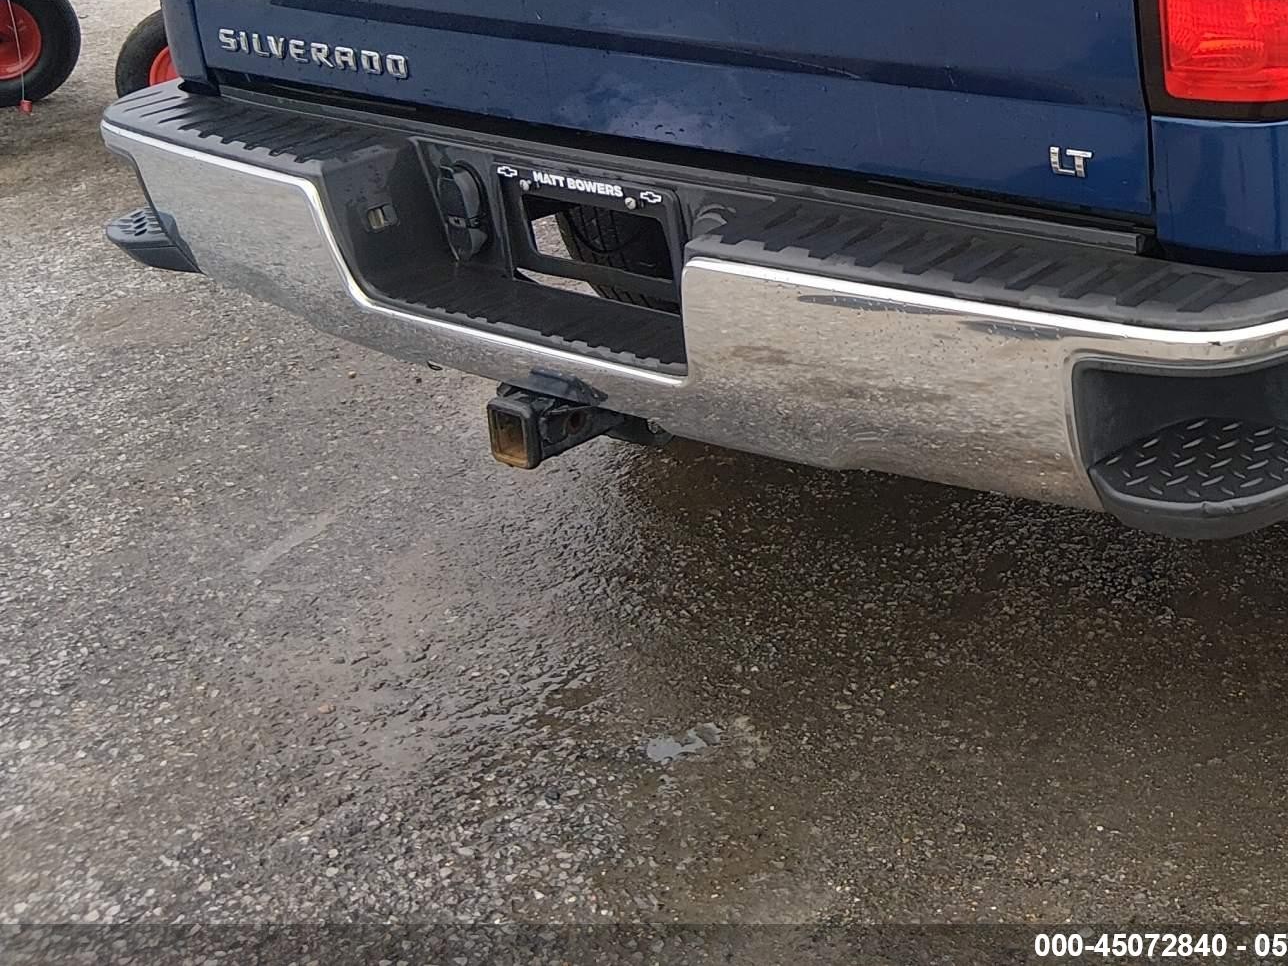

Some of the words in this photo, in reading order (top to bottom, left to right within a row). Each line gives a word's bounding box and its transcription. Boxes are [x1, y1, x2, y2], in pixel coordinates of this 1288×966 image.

[218, 28, 409, 80] SILVERADO
[1049, 146, 1093, 178] LT
[532, 170, 565, 188] MATT
[566, 177, 624, 198] BOWERS
